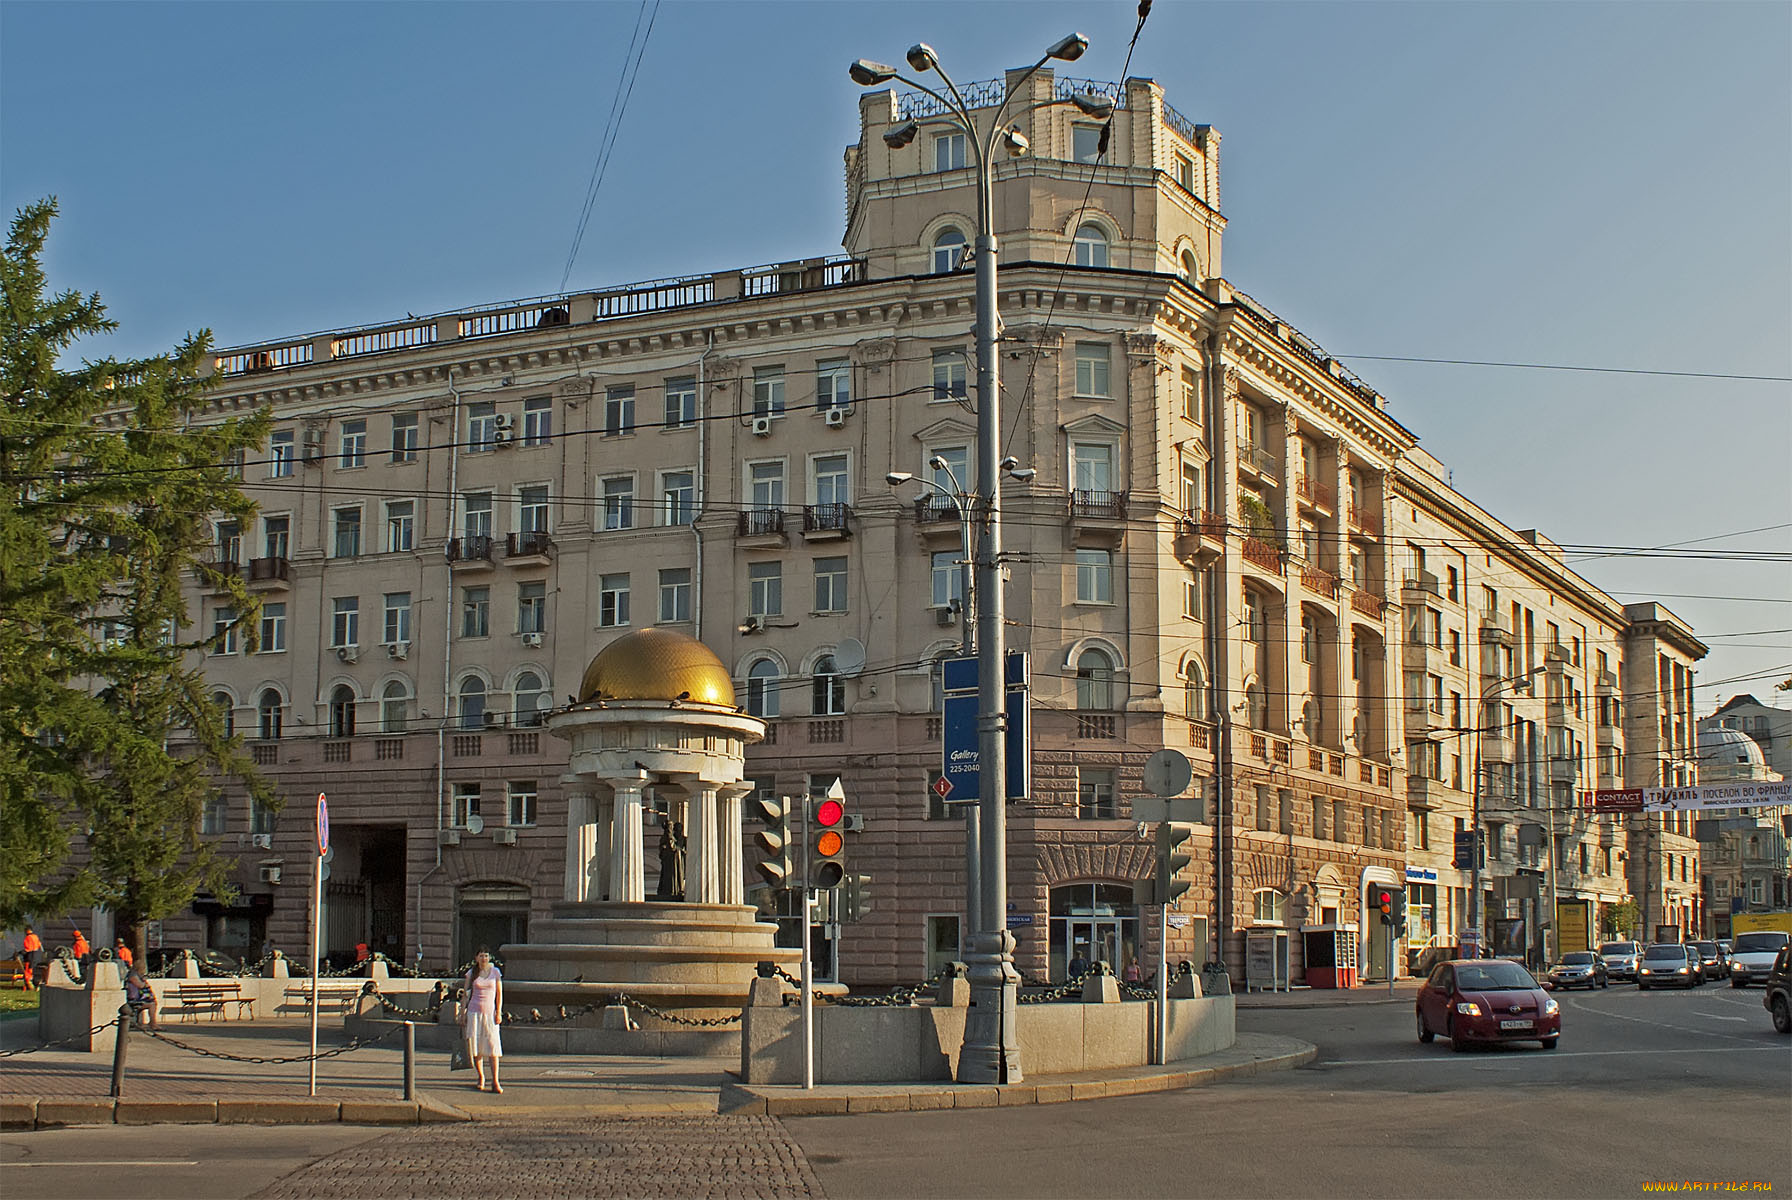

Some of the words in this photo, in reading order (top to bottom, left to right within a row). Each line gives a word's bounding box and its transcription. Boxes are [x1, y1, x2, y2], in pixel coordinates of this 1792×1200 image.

[950, 749, 979, 762] Gallery
[949, 764, 980, 773] 225-2040
[1597, 793, 1640, 802] CONTACT
[1703, 787, 1739, 799] ПОСЕЛОК
[1743, 787, 1754, 797] ВО
